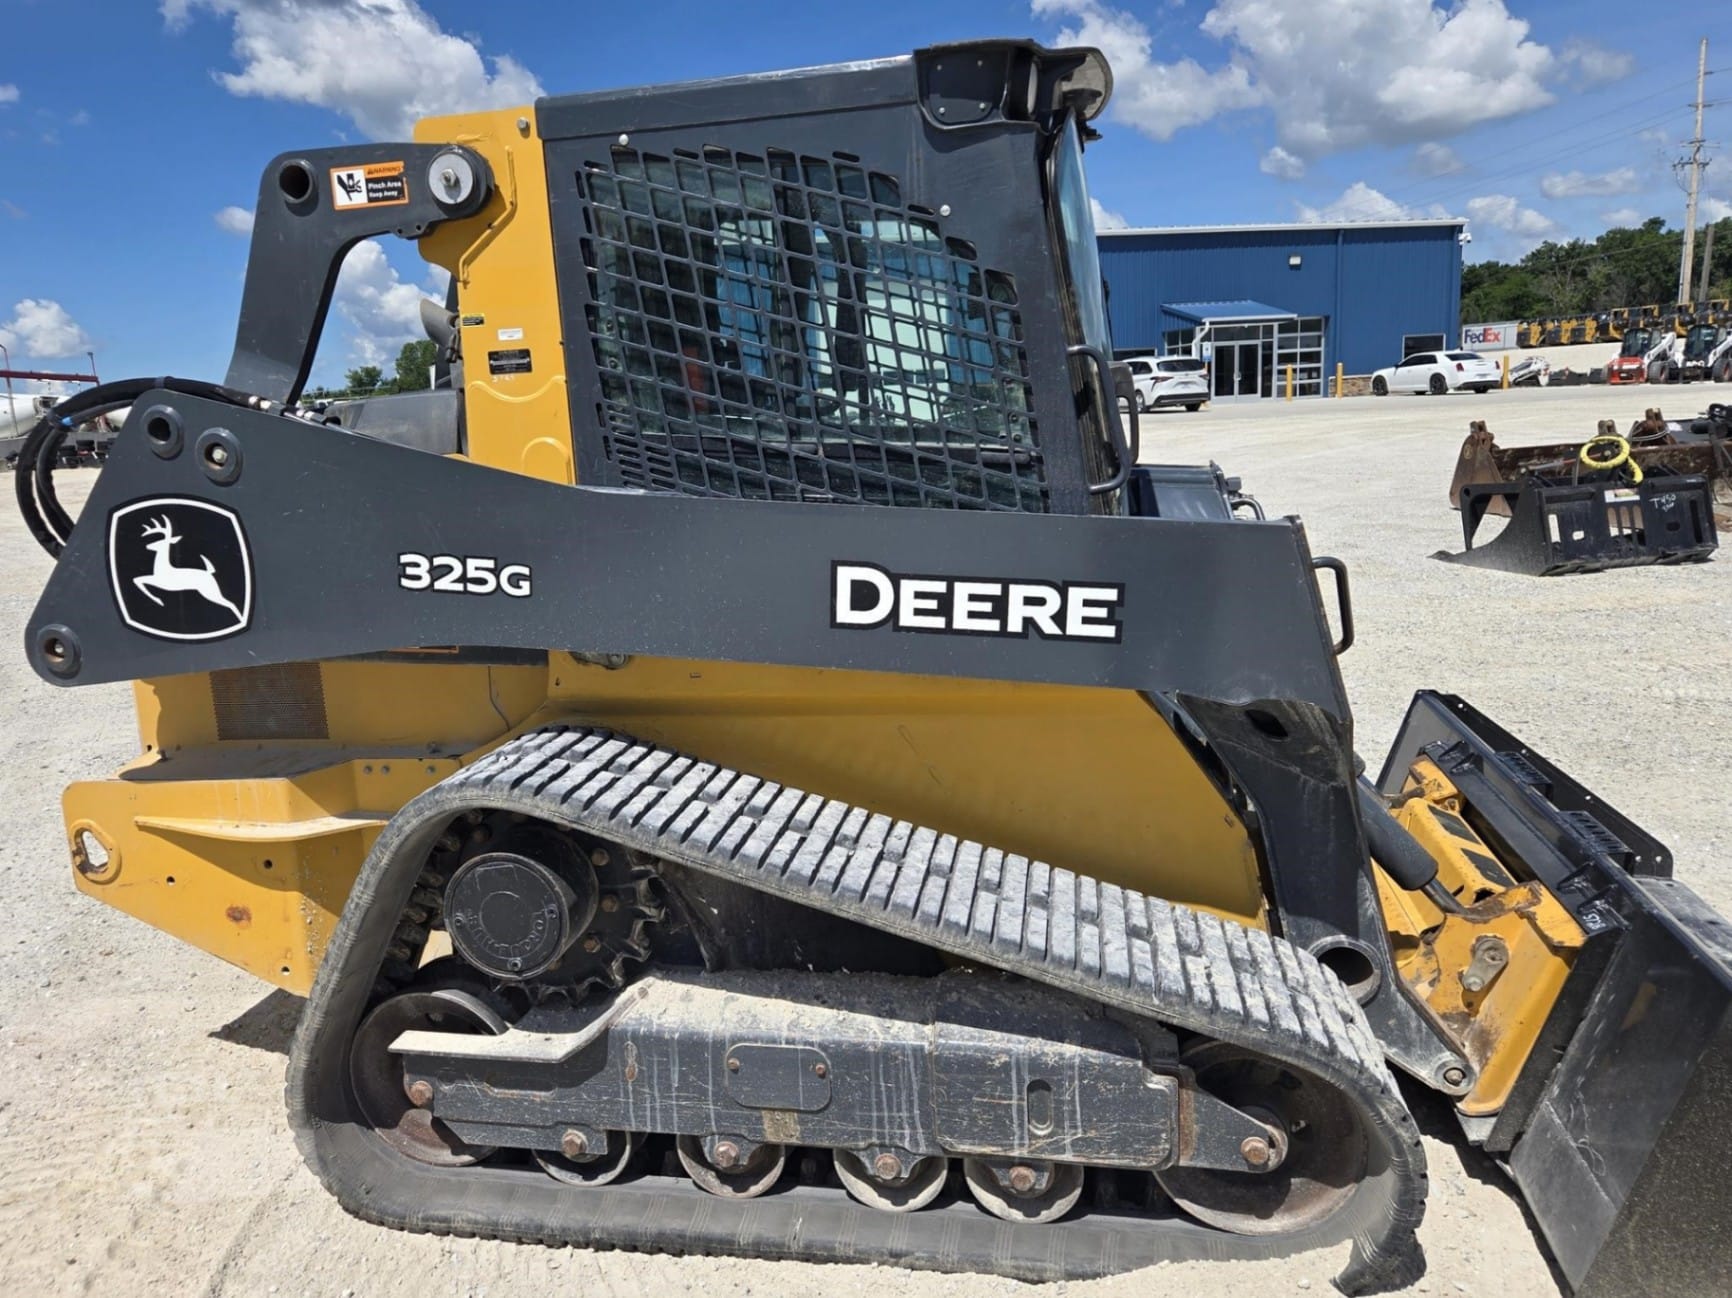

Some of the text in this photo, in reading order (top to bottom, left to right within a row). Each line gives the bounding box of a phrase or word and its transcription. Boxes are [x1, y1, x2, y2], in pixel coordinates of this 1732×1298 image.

[368, 180, 402, 190] Pinch Area
[368, 190, 398, 199] Keep Away
[1464, 327, 1501, 343] FedEx
[399, 552, 531, 598] 325G
[835, 565, 1119, 639] DEERE
